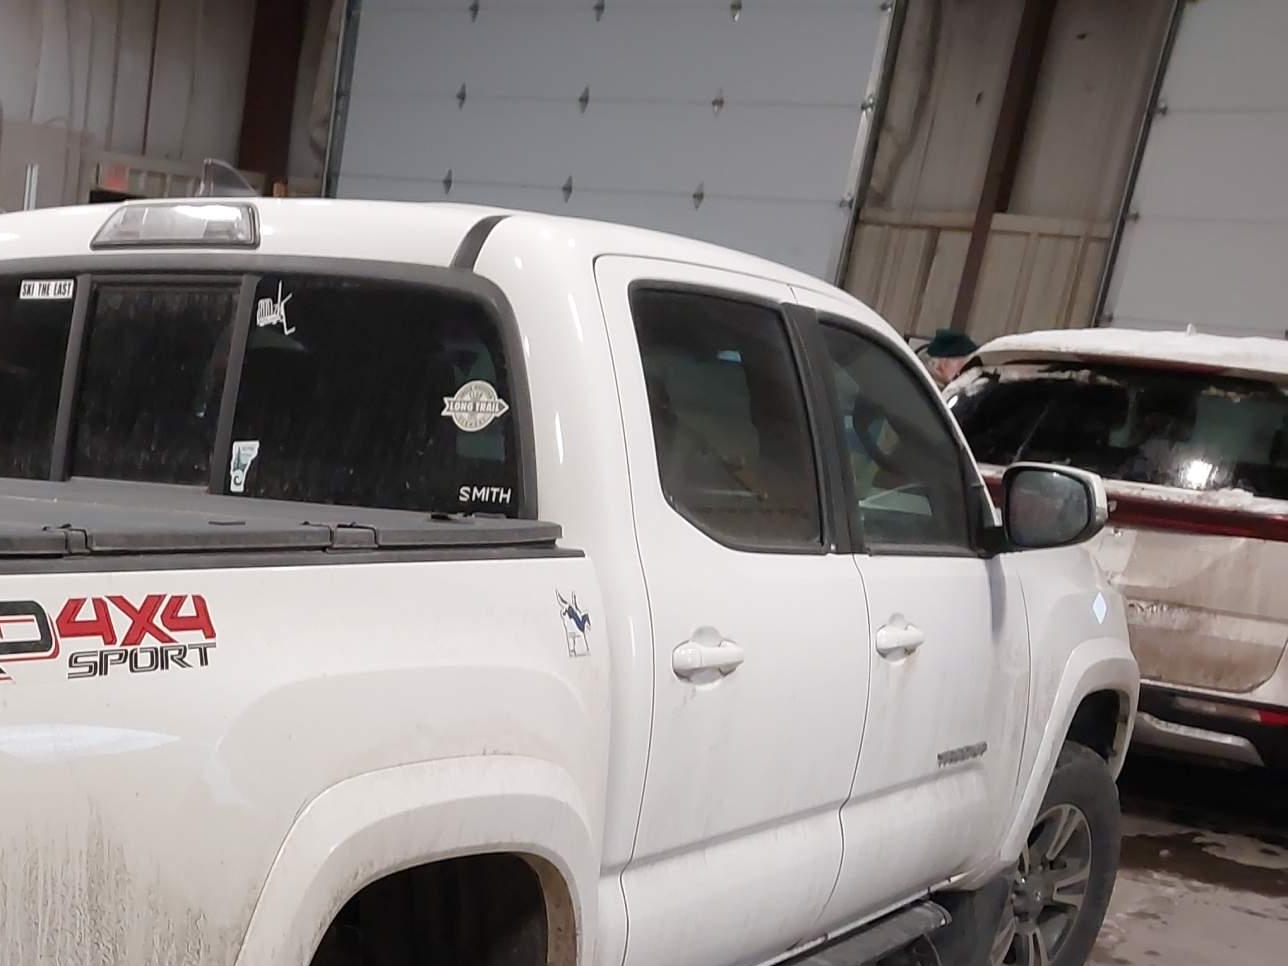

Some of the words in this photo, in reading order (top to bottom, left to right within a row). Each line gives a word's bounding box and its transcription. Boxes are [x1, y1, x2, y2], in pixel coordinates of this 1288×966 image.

[22, 283, 35, 297] SKI
[38, 283, 50, 297] THE
[449, 402, 473, 412] LONG
[475, 402, 500, 413] TRAIL
[458, 486, 512, 504] SMITH
[67, 642, 216, 680] SPORT
